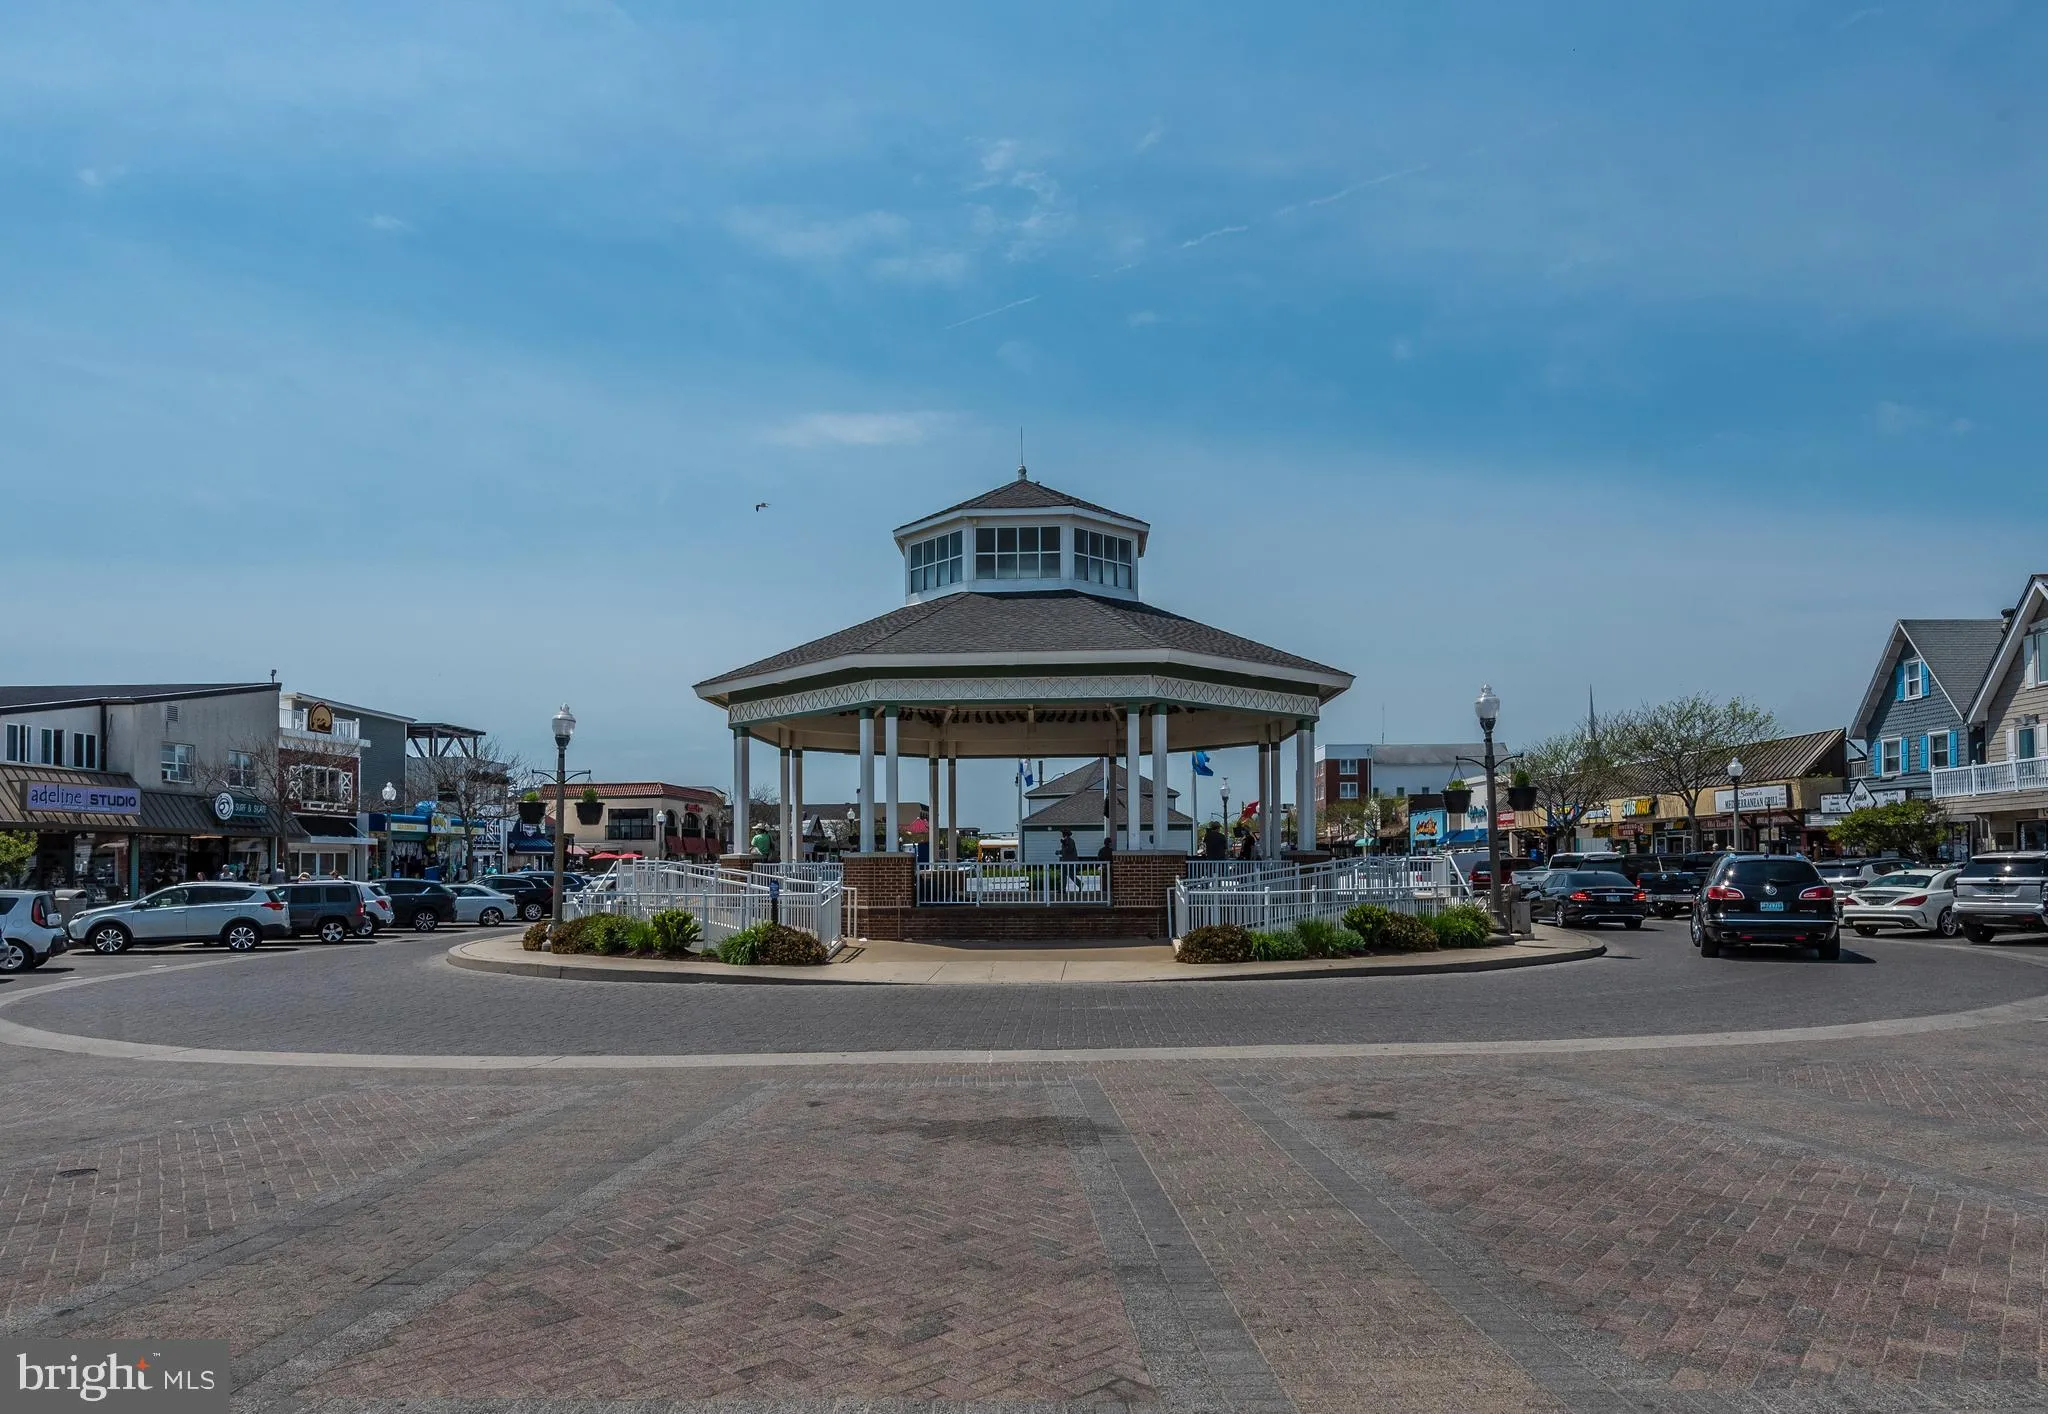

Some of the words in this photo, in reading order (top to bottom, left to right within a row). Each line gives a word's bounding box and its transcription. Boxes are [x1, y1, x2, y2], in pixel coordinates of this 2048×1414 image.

[31, 783, 82, 805] adeline
[90, 793, 137, 807] STUDIO
[1724, 796, 1764, 809] MEDERRANEAN
[1622, 799, 1651, 816] SUBWAY
